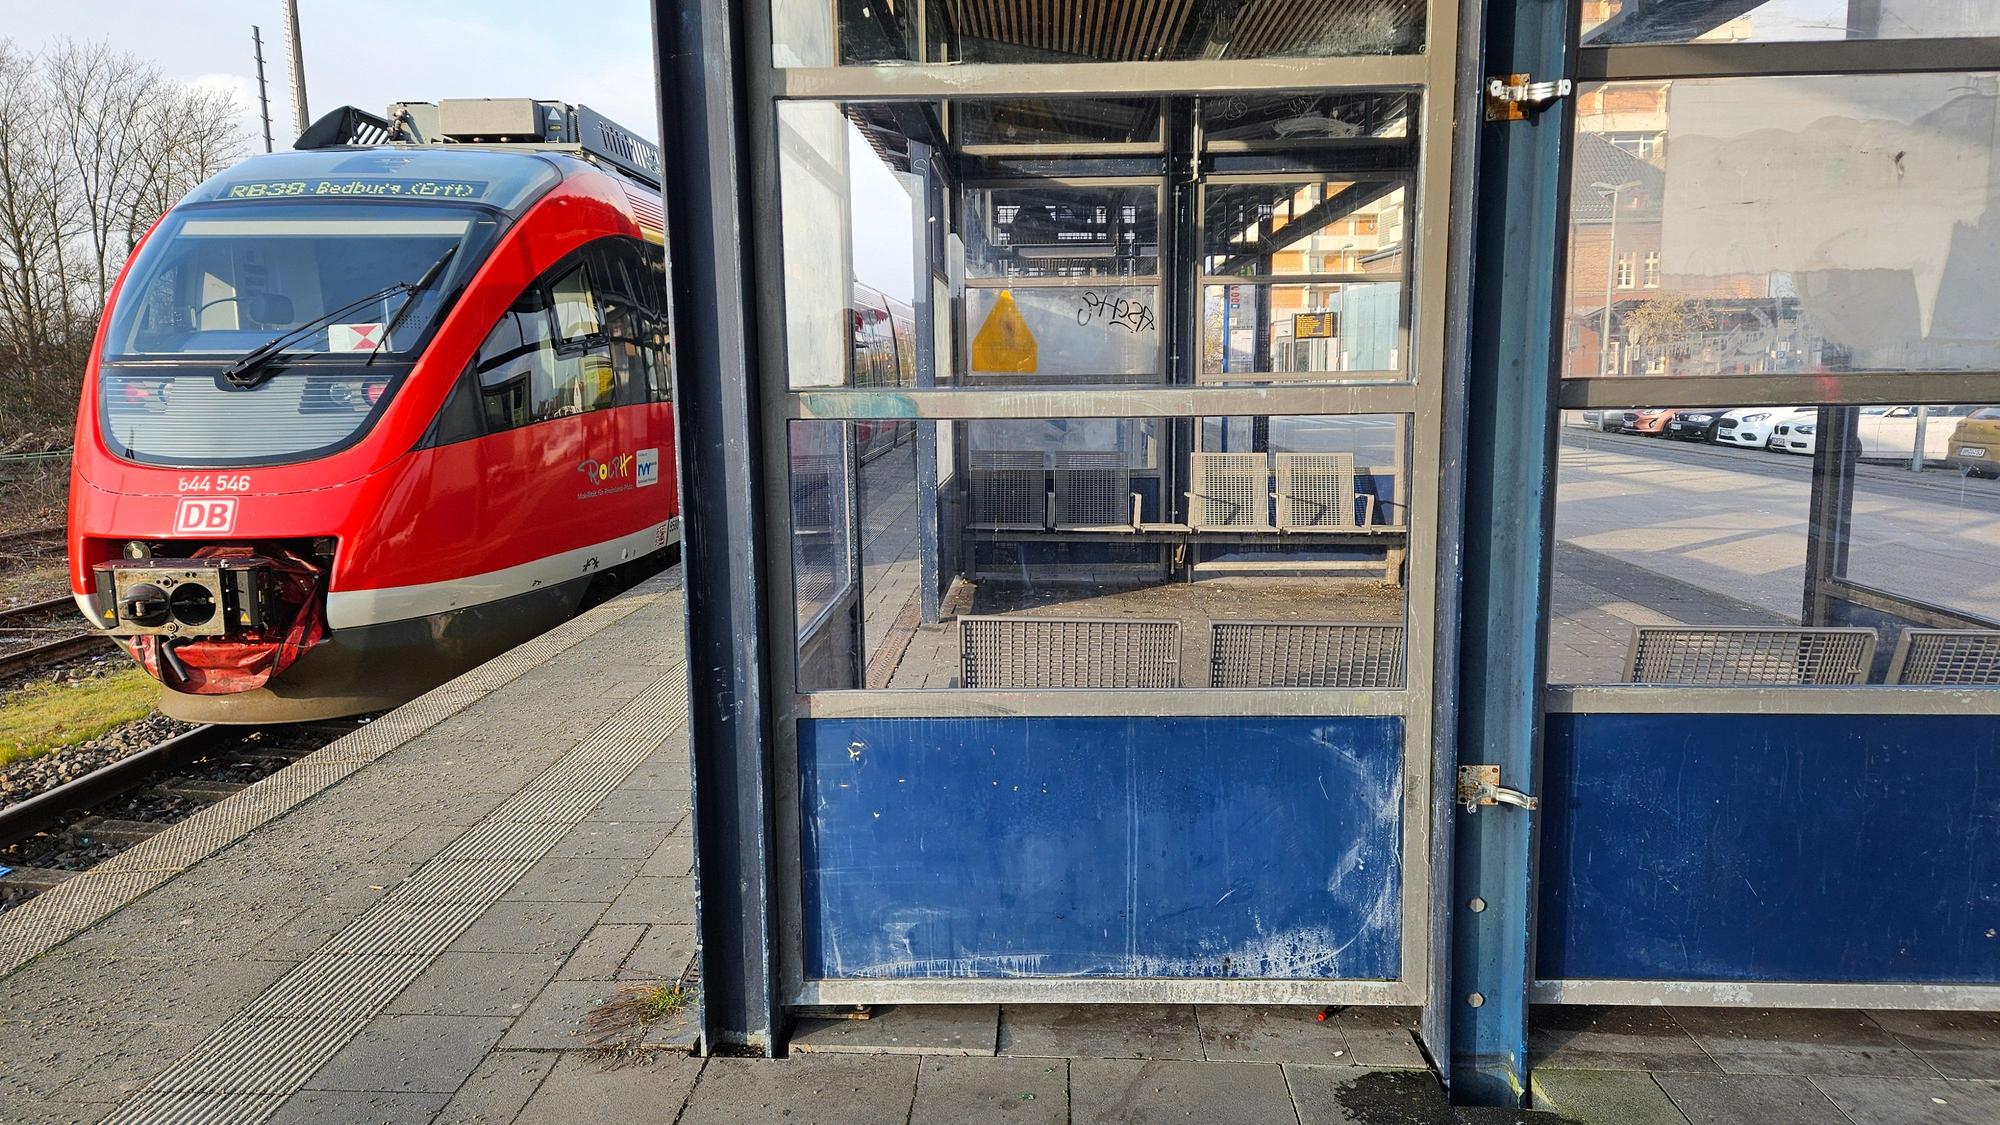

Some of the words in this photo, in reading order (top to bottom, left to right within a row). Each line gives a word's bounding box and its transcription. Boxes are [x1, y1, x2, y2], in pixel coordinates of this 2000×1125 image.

[229, 182, 305, 198] RB38
[315, 181, 401, 195] Bedburg
[411, 182, 473, 197] (Erft)
[577, 453, 633, 486] ROLPH
[178, 475, 211, 492] 644
[215, 475, 251, 491] 546
[181, 503, 229, 529] DB
